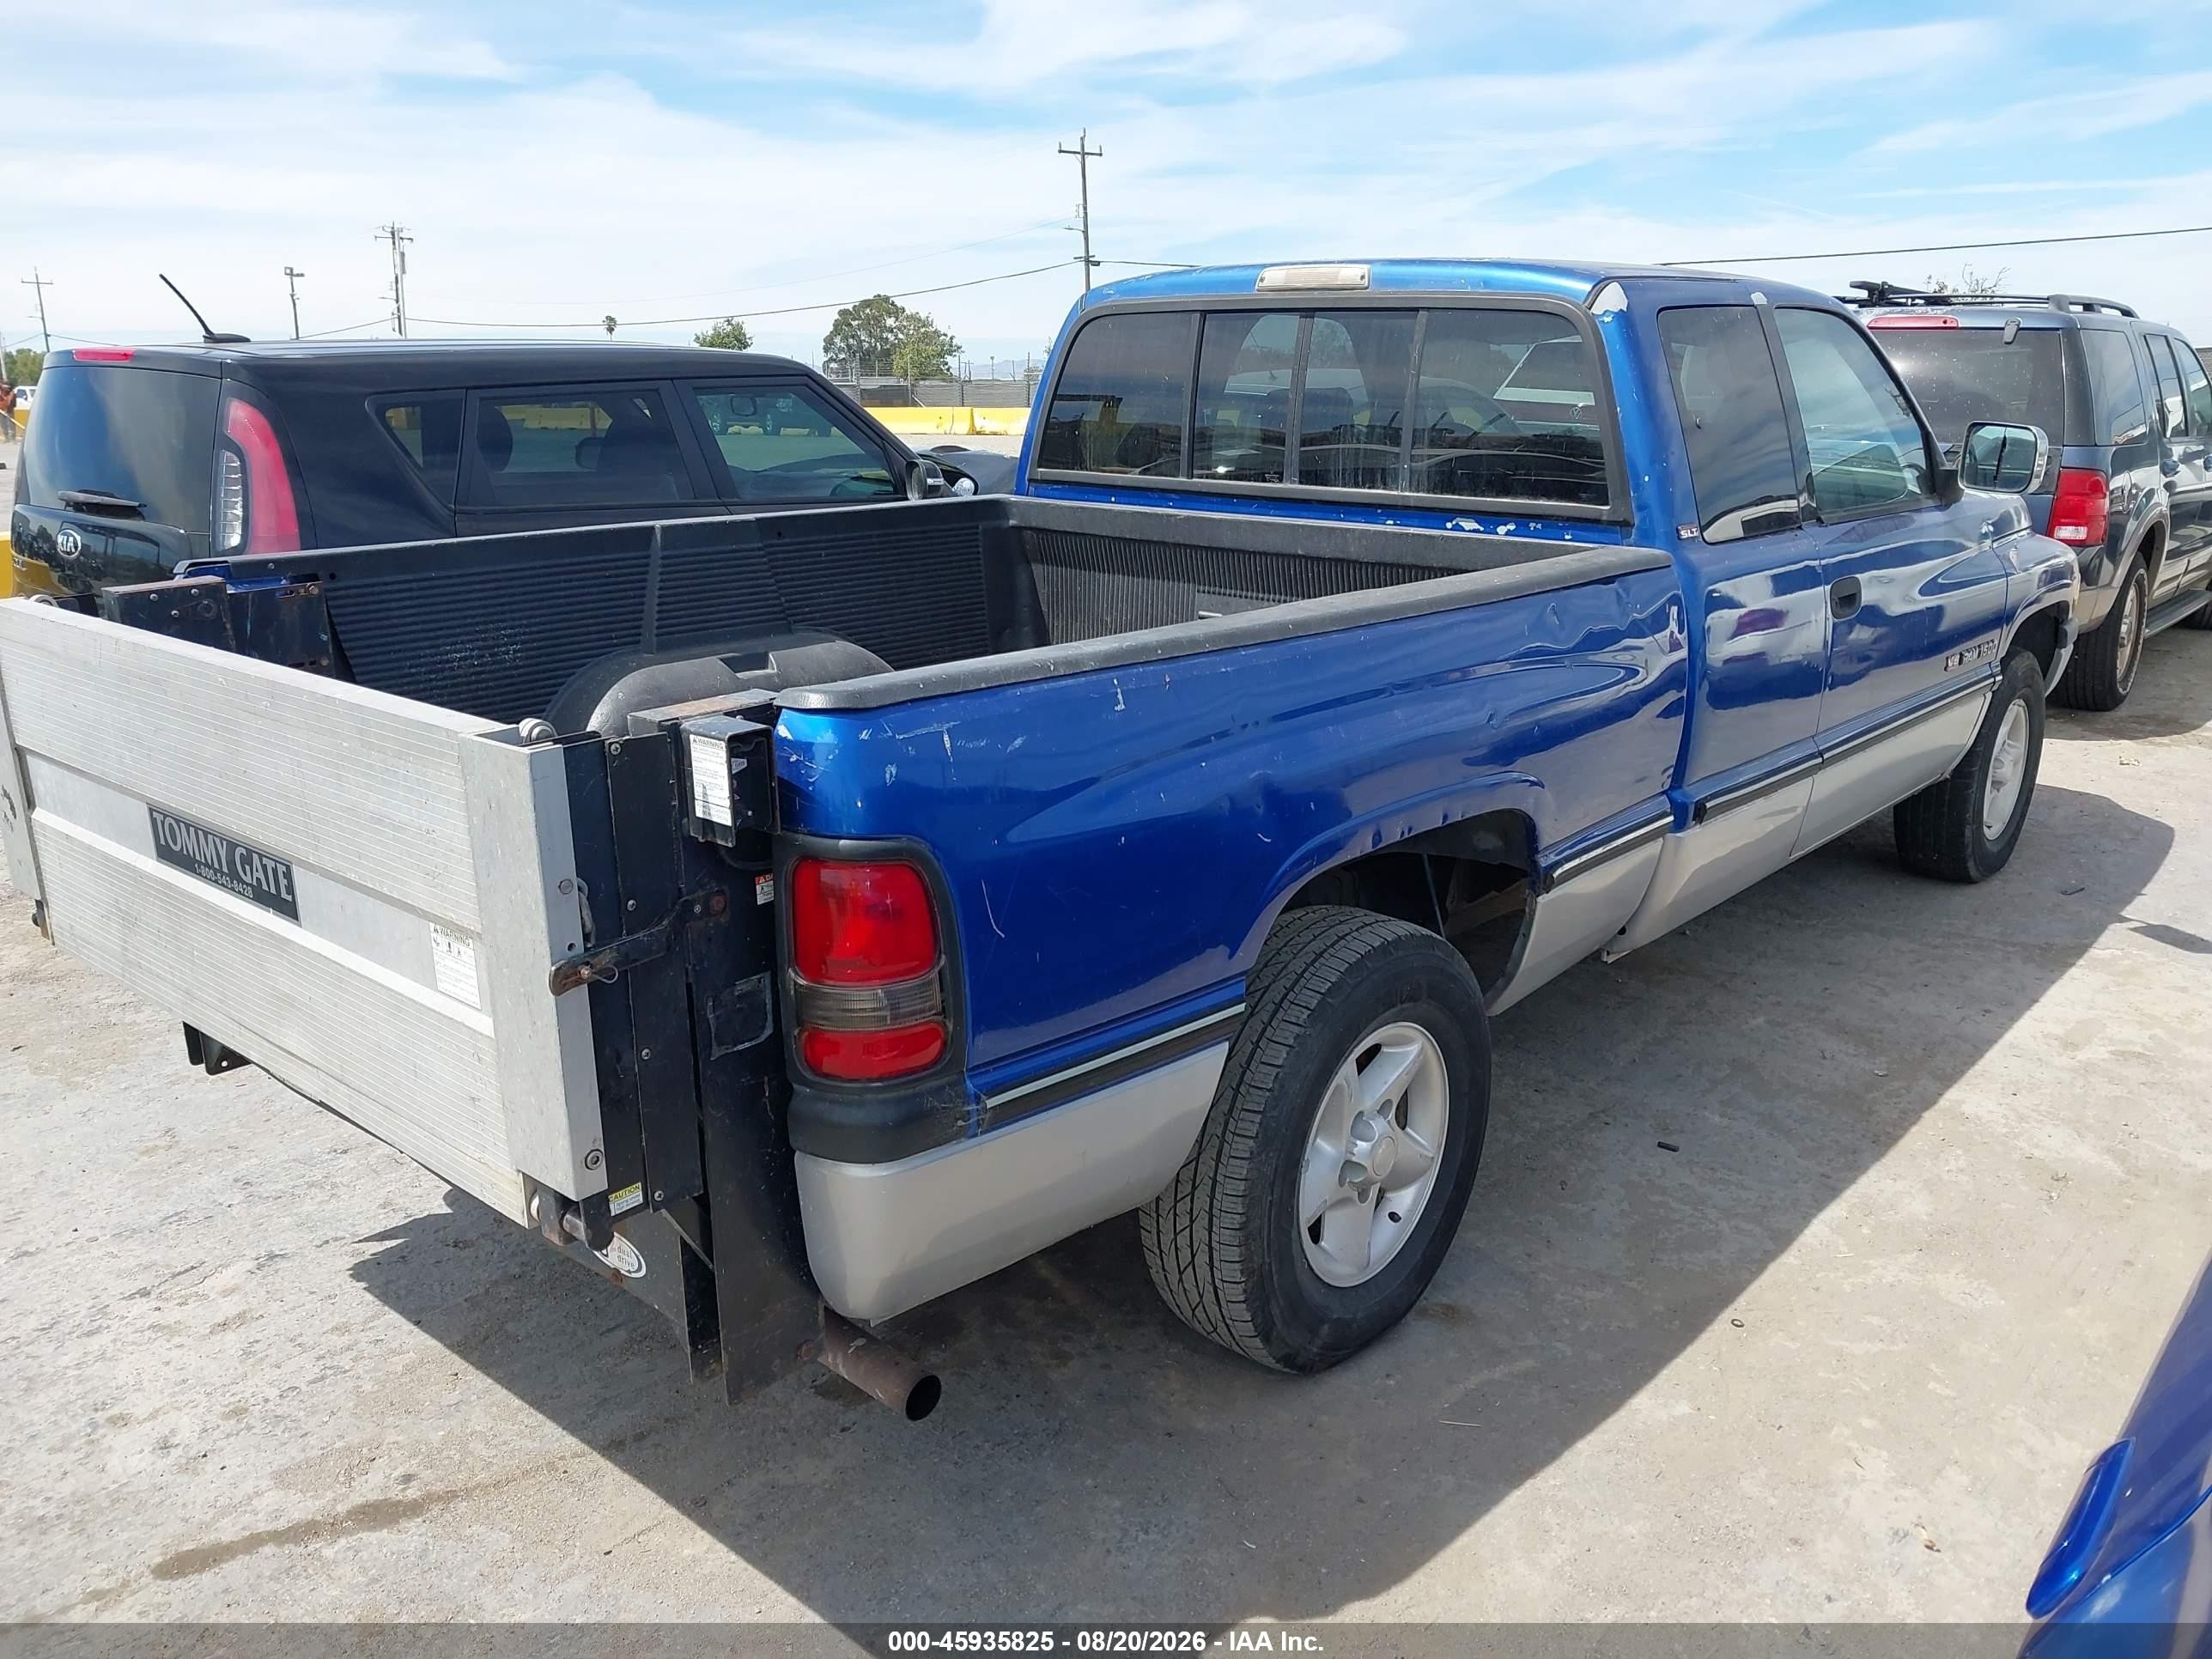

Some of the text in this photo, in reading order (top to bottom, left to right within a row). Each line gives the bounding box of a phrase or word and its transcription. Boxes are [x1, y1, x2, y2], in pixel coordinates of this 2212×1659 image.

[1680, 526, 1699, 539] SLT
[58, 534, 76, 552] KIA
[1963, 647, 1978, 664] RAM
[1979, 639, 1998, 659] 1500
[697, 738, 724, 750] WARNING
[152, 811, 294, 902] TOMMY GATE
[194, 863, 254, 899] 1-800-543-8428
[439, 926, 471, 947] WARNING
[609, 1183, 641, 1203] CAUTION
